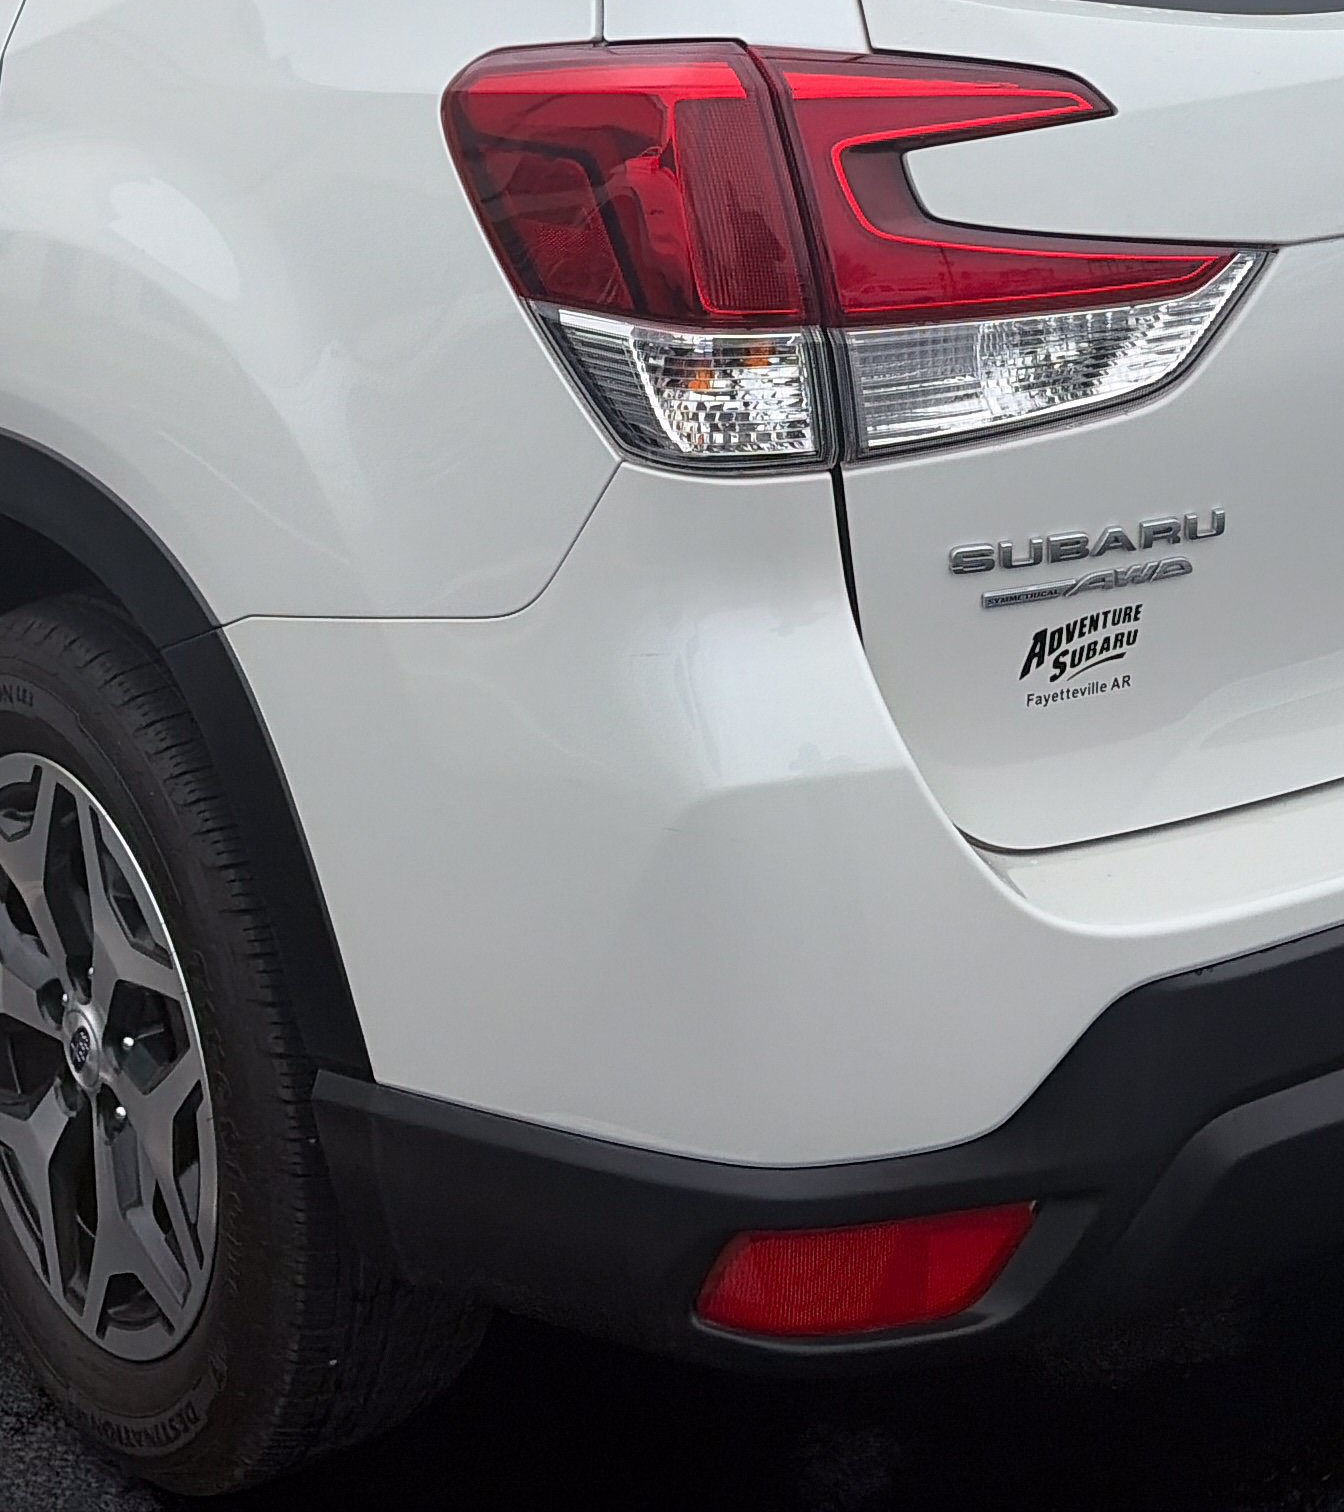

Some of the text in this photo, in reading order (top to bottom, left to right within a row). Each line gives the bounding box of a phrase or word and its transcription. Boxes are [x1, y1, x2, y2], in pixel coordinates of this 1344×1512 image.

[949, 506, 1226, 575] SUBARU
[1062, 556, 1193, 598] AWD
[1019, 604, 1143, 681] ADVENTURE
[1049, 629, 1139, 683] SUBARU
[1026, 675, 1131, 707] Fayetteville AR
